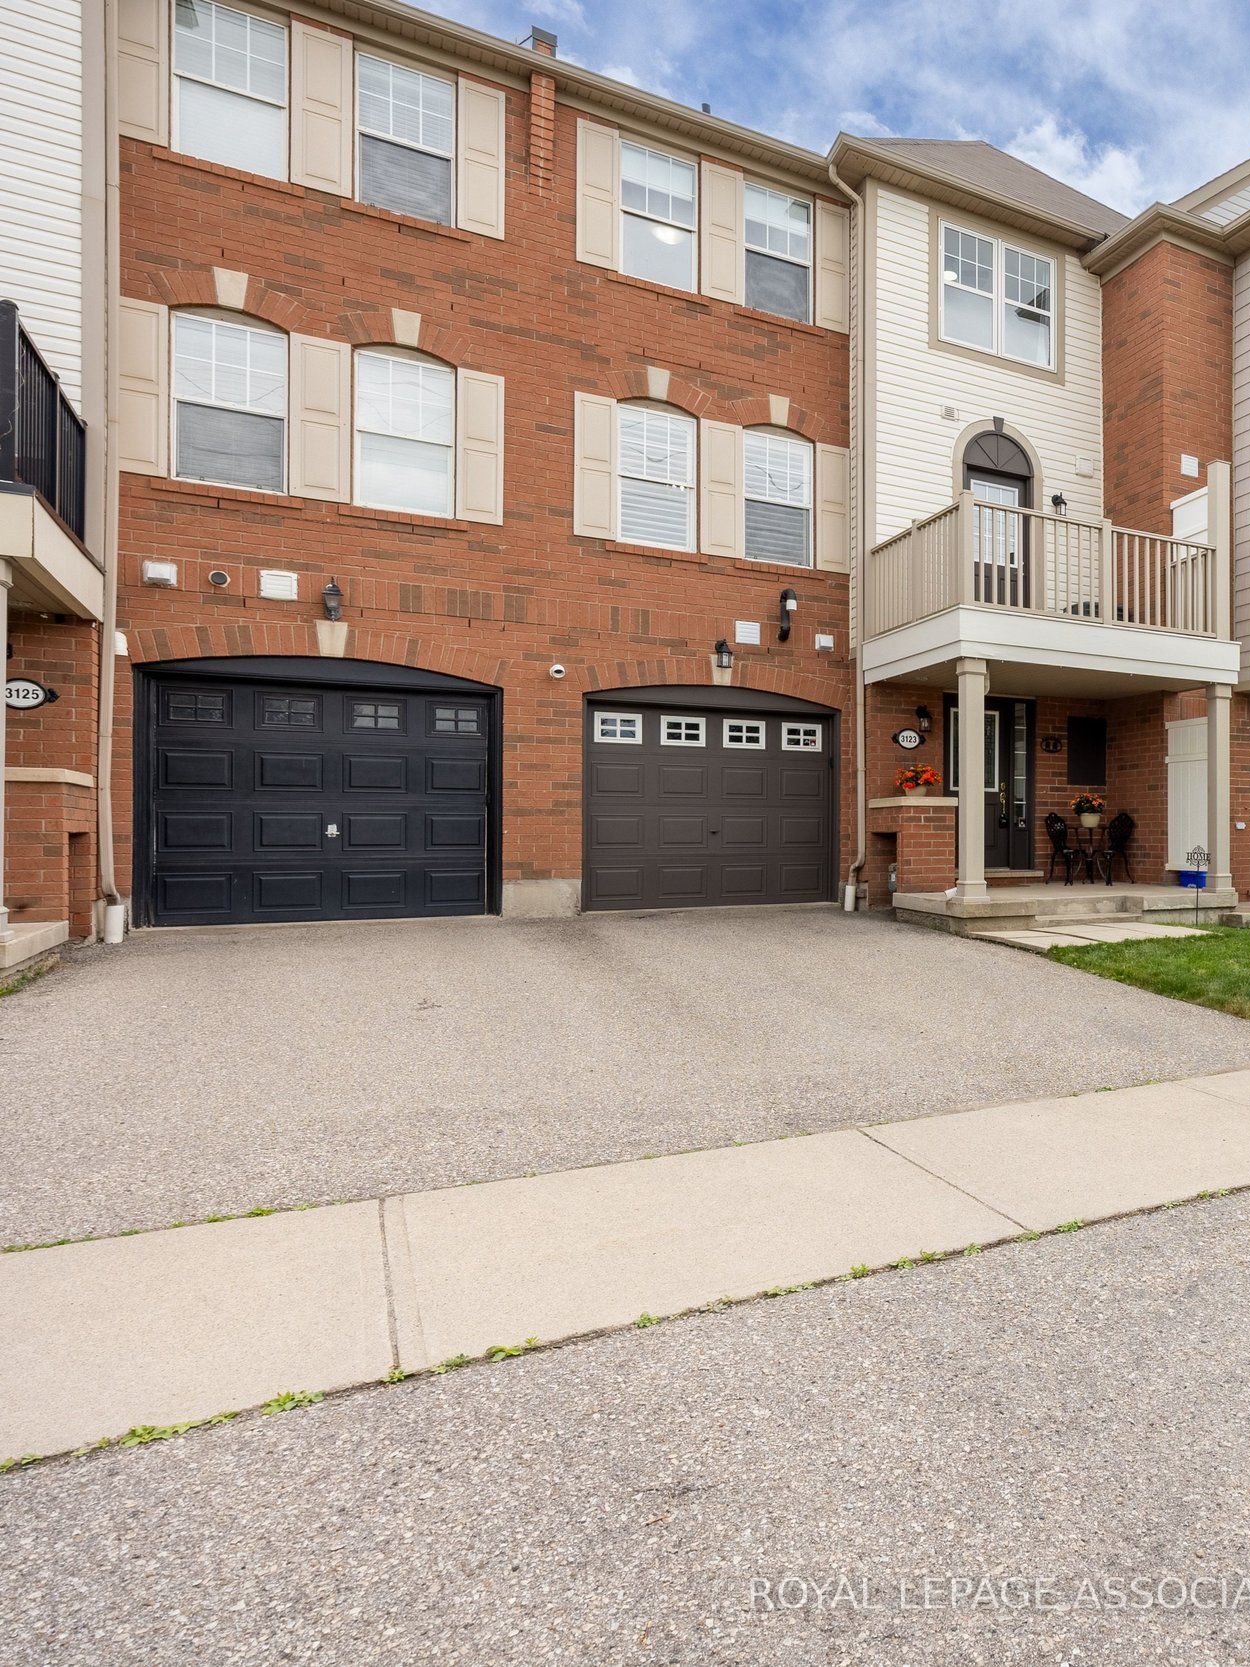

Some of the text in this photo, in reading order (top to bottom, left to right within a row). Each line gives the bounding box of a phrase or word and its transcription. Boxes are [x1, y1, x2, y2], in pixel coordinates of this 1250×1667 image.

[5, 687, 40, 700] 3125
[900, 735, 917, 743] 3123
[1186, 851, 1211, 862] HOME
